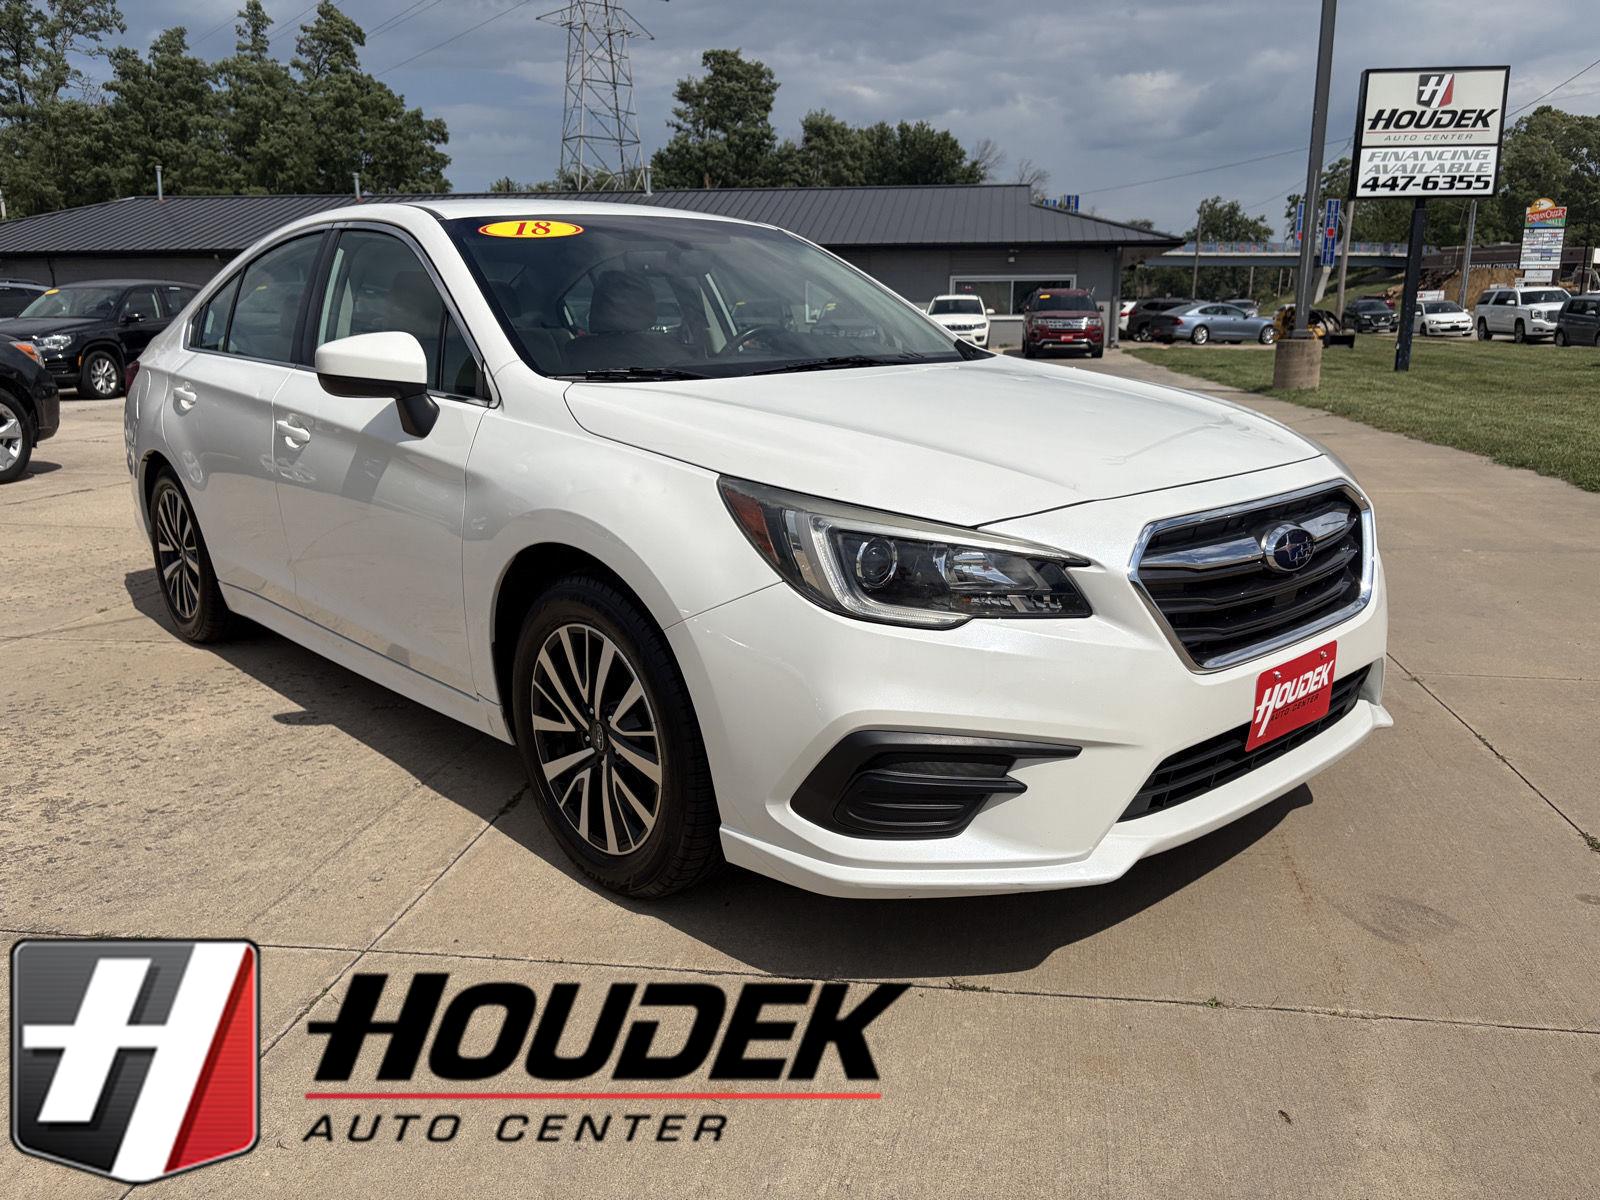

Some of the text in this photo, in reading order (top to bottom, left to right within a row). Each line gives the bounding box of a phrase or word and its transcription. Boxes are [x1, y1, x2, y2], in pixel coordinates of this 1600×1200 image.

[1367, 108, 1499, 130] HOUDEK
[1423, 133, 1473, 141] CENTER
[1367, 149, 1491, 162] FINANCING
[1364, 162, 1492, 175] AVAILABLE
[1361, 175, 1492, 192] 447-6355
[514, 222, 551, 236] 18
[1254, 659, 1335, 738] HOUDEK
